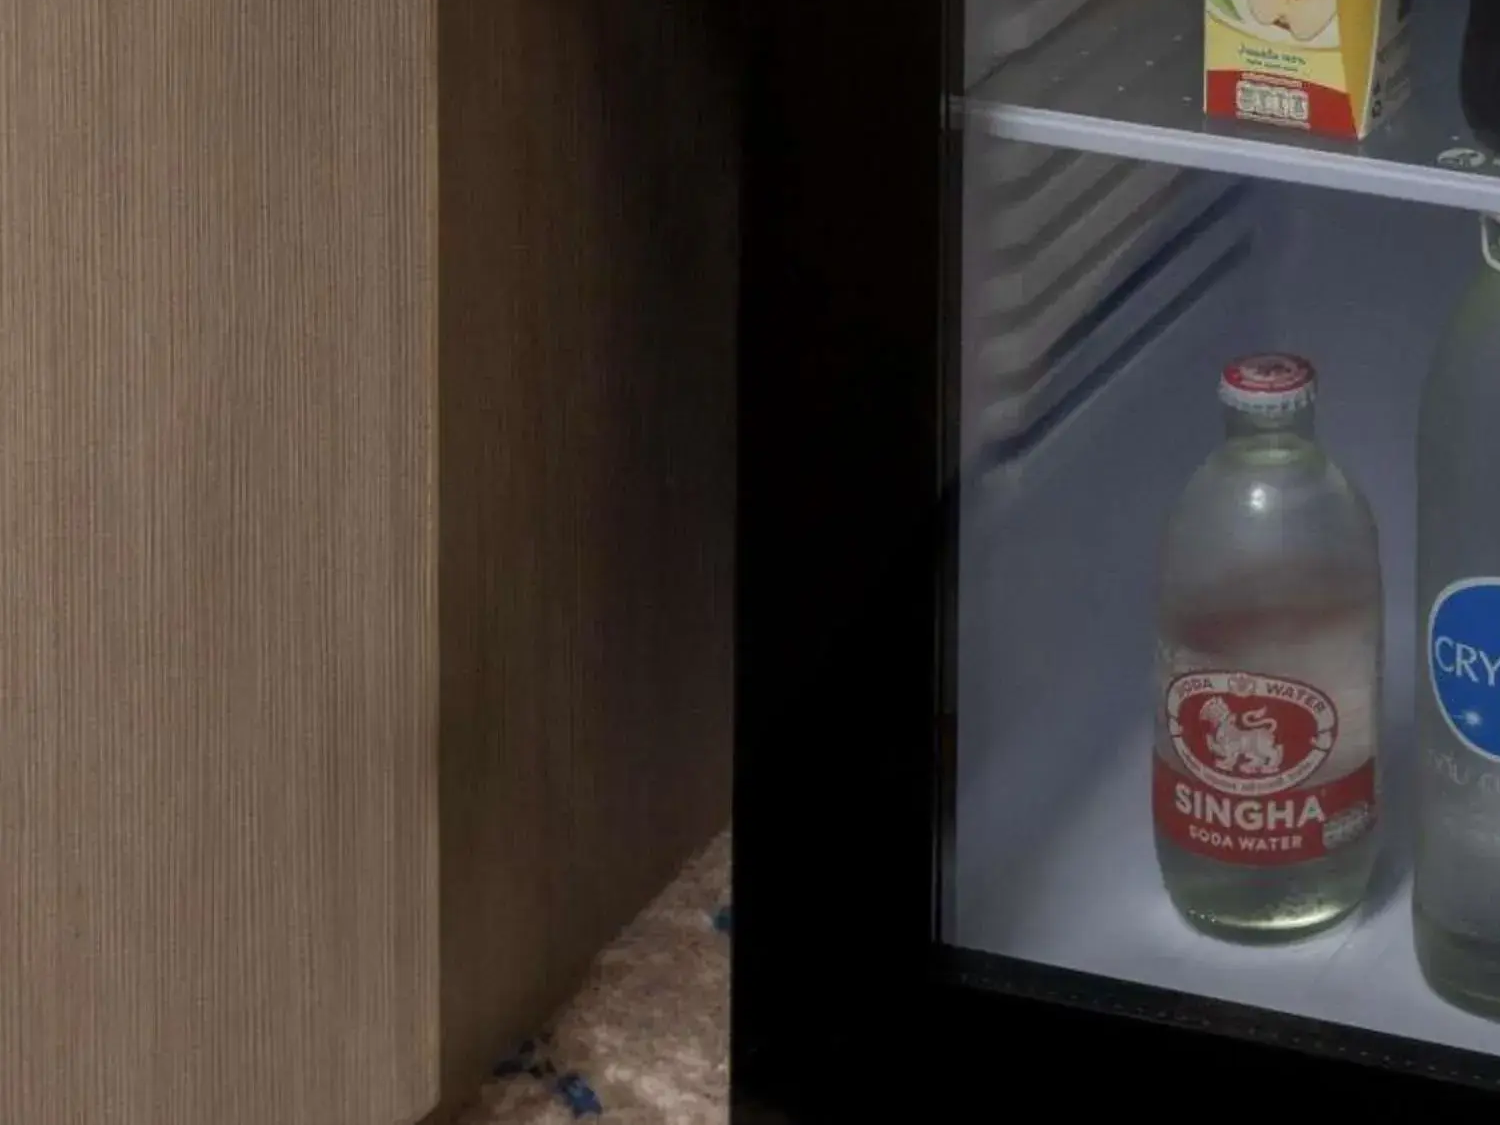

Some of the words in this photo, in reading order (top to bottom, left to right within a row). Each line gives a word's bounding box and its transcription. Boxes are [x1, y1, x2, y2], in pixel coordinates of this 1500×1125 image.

[1266, 681, 1328, 714] WATER
[1174, 782, 1326, 831] SINGHA
[1188, 824, 1234, 850] SODA
[1238, 834, 1303, 852] WATER
